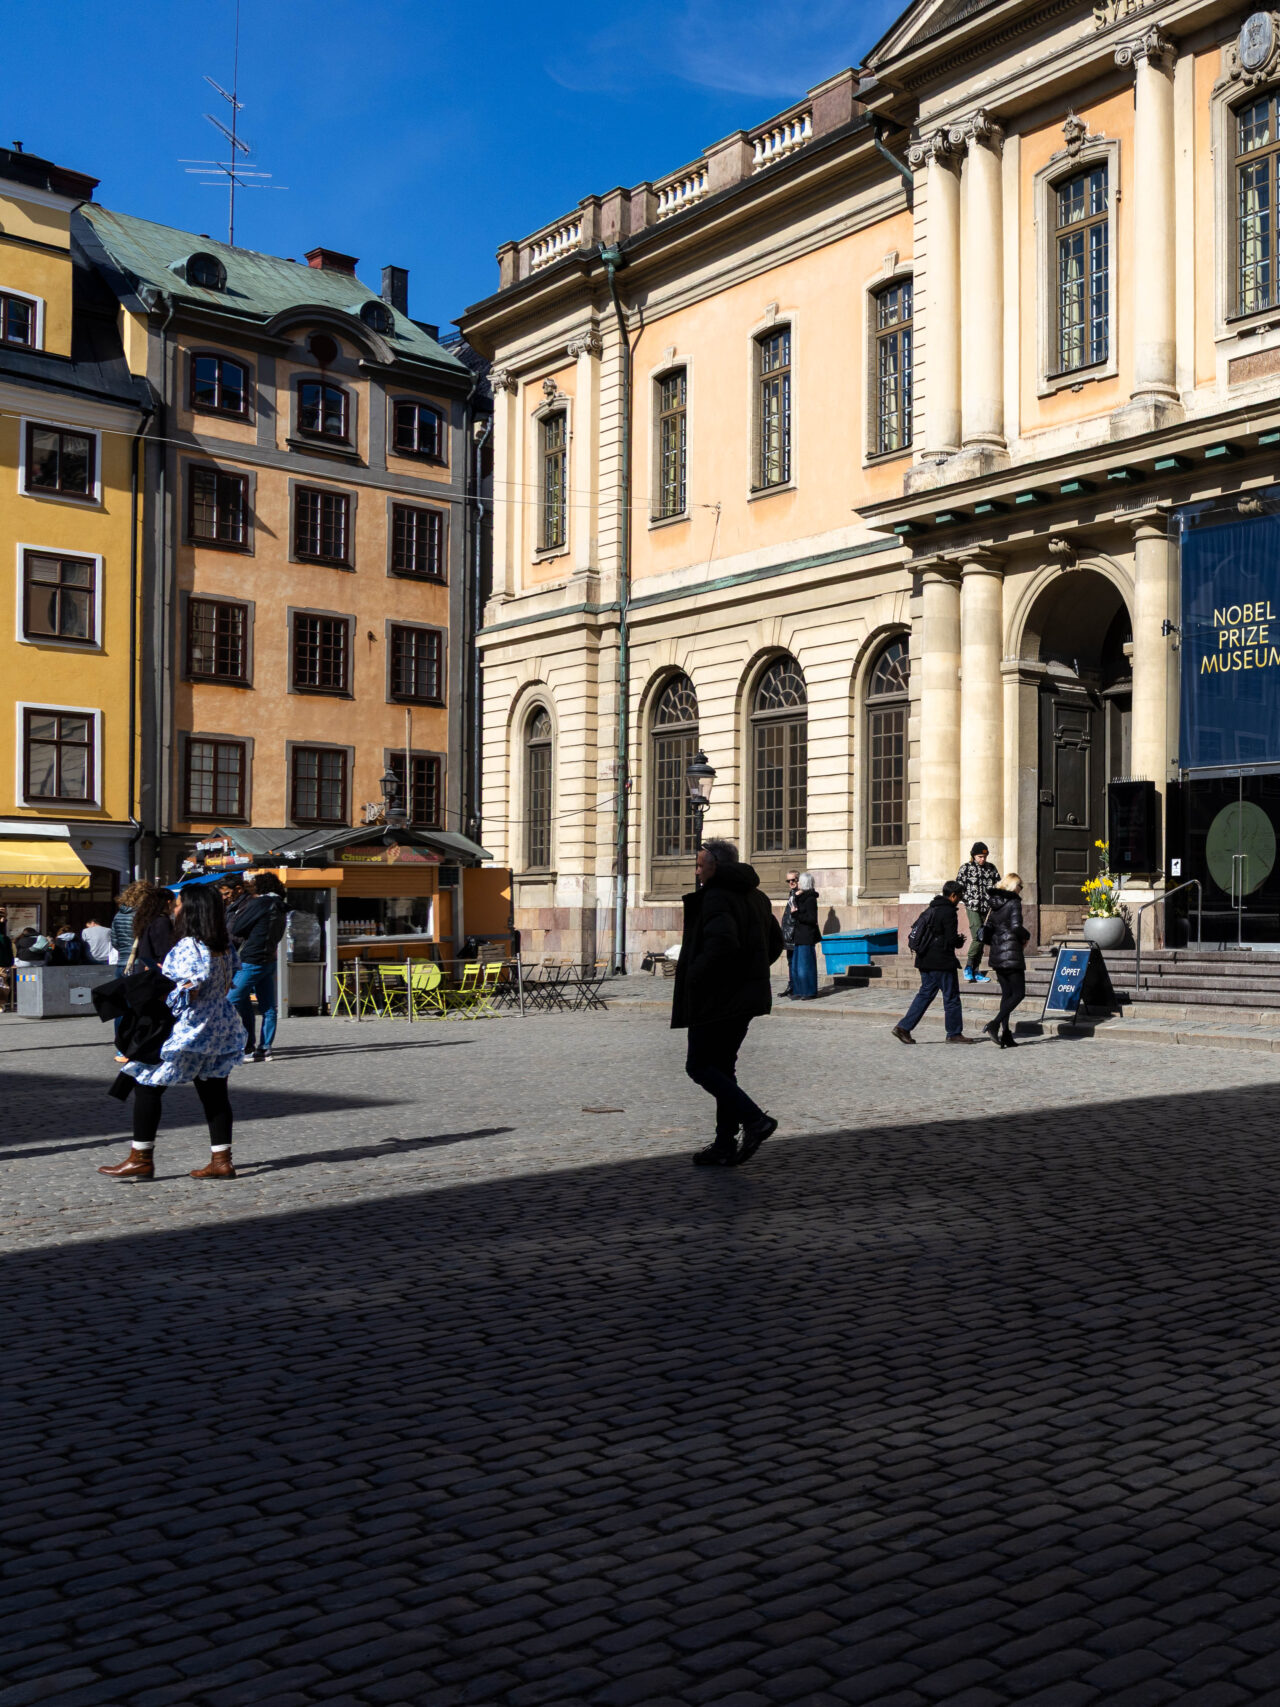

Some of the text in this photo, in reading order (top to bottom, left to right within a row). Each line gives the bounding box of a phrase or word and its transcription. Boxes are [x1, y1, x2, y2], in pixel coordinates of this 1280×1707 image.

[1213, 601, 1277, 628] NOBEL
[1218, 625, 1270, 650] PRIZE
[341, 853, 382, 862] Churros
[1061, 966, 1081, 976] ÖPPET
[1057, 984, 1076, 993] OPEN
